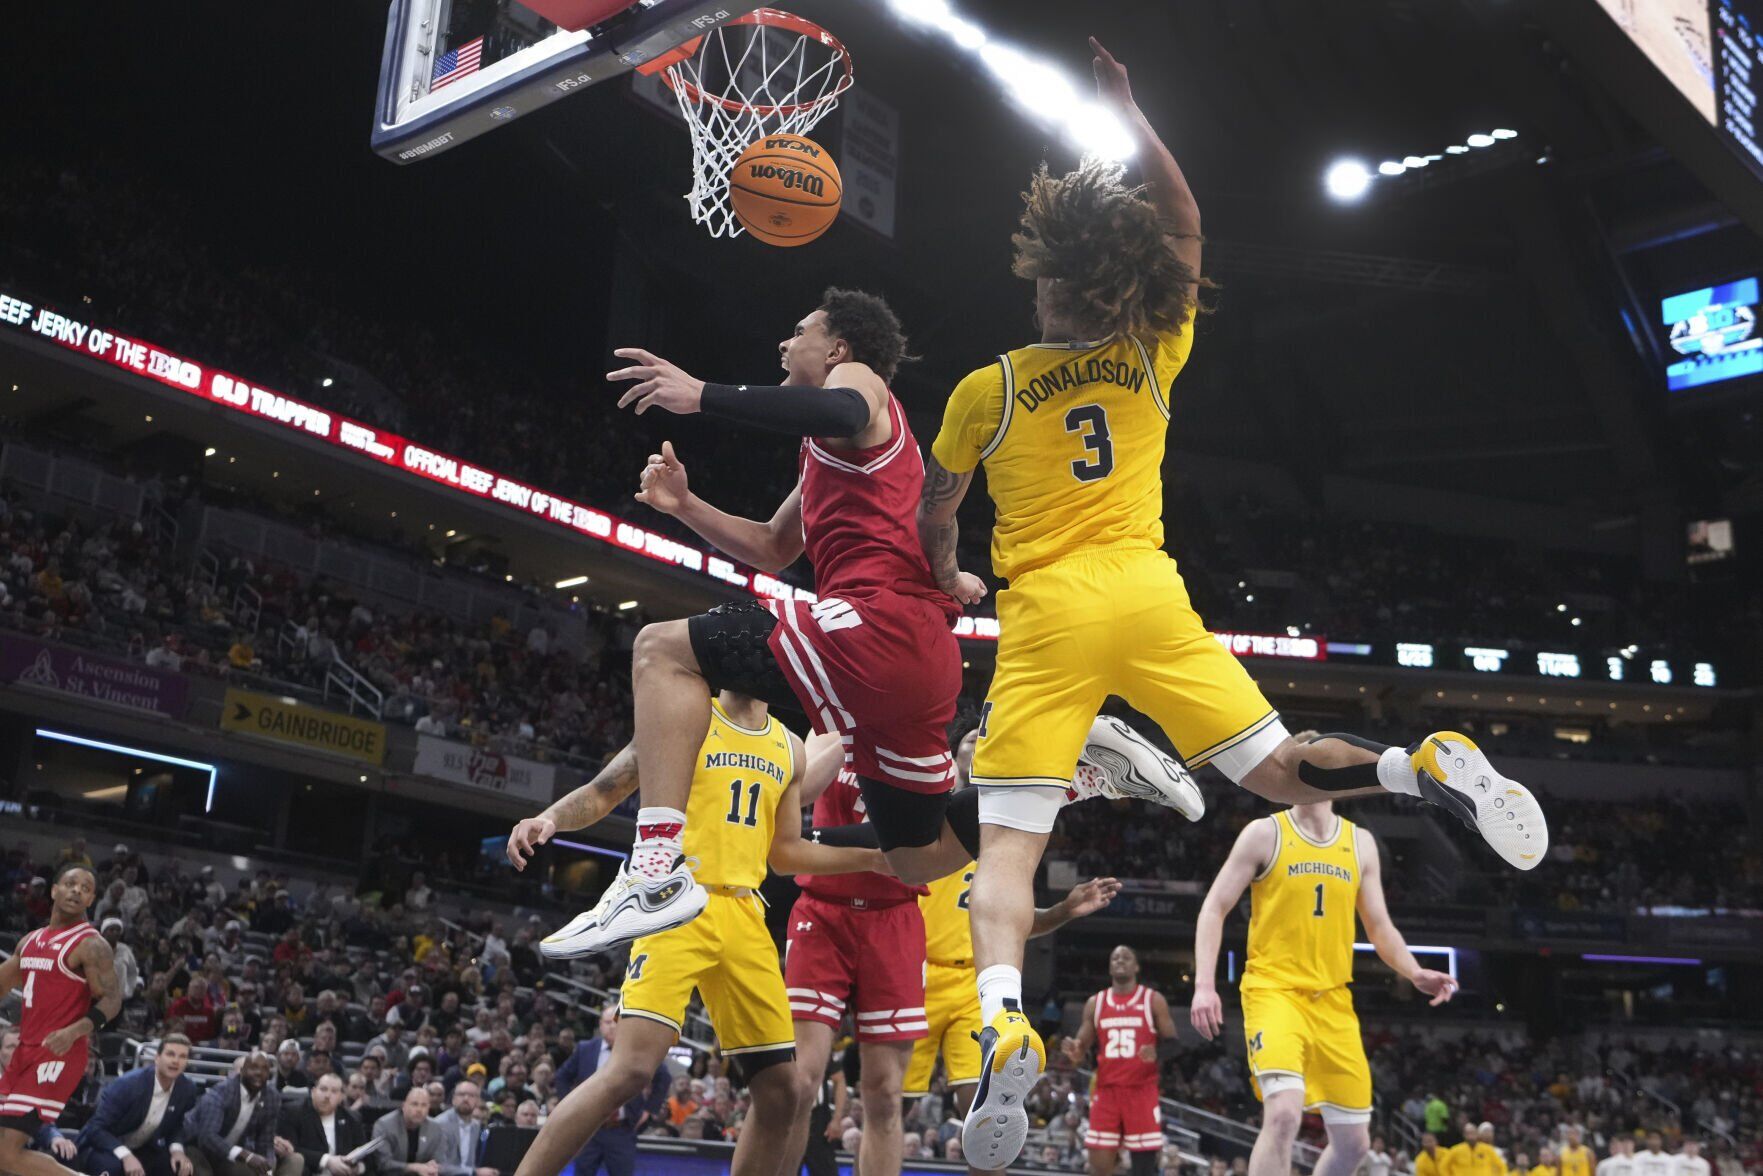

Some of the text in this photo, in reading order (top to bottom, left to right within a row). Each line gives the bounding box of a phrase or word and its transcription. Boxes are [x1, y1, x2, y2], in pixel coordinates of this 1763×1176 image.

[690, 9, 731, 29] IFS.ai
[556, 72, 592, 92] IFS.ai
[765, 139, 820, 159] NCAA
[751, 164, 824, 198] Wilson
[31, 309, 89, 346] JERKY
[88, 329, 114, 355] OF
[115, 337, 147, 370] THE
[1016, 358, 1145, 413] DONALDSON
[211, 374, 331, 436] OLD TRAPPER
[1064, 403, 1115, 483] 3
[404, 445, 460, 484] OFFICIAL
[460, 464, 493, 493] BEEF
[492, 478, 532, 508] JERKY
[531, 491, 550, 514] OF
[549, 497, 573, 524] THE
[811, 598, 863, 633] W
[1233, 635, 1251, 653] OF
[1250, 636, 1275, 655] THE
[71, 656, 160, 690] Ascension
[92, 681, 160, 710] Vincent
[258, 707, 377, 753] GAINBRIDGE
[705, 752, 784, 785] MICHIGAN
[726, 779, 761, 827] 11
[1288, 862, 1351, 882] MICHIGAN
[1313, 883, 1324, 917] 1
[23, 971, 36, 1008] 4
[1105, 1029, 1136, 1058] 25
[37, 1060, 66, 1085] W
